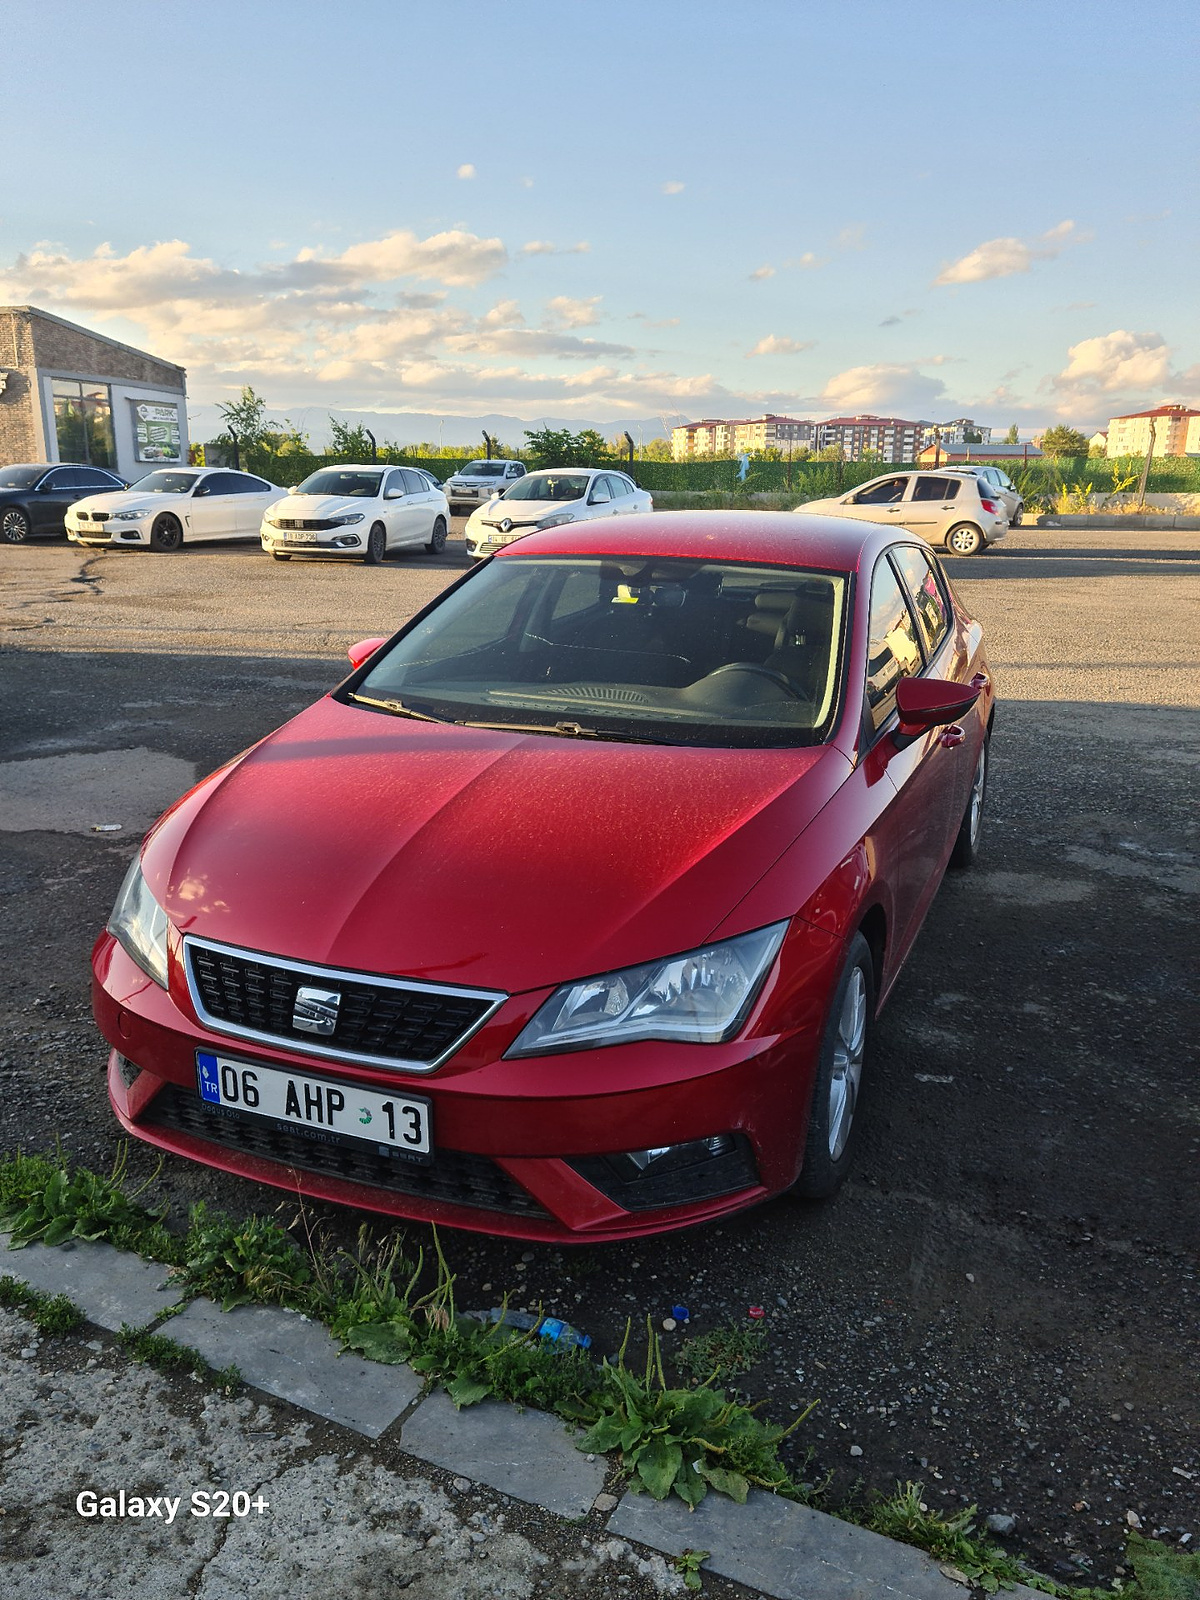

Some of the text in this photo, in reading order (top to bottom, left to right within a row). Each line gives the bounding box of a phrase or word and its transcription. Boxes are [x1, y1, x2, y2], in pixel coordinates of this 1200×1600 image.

[204, 1080, 218, 1094] TR
[221, 1065, 422, 1145] 06 AHP 13
